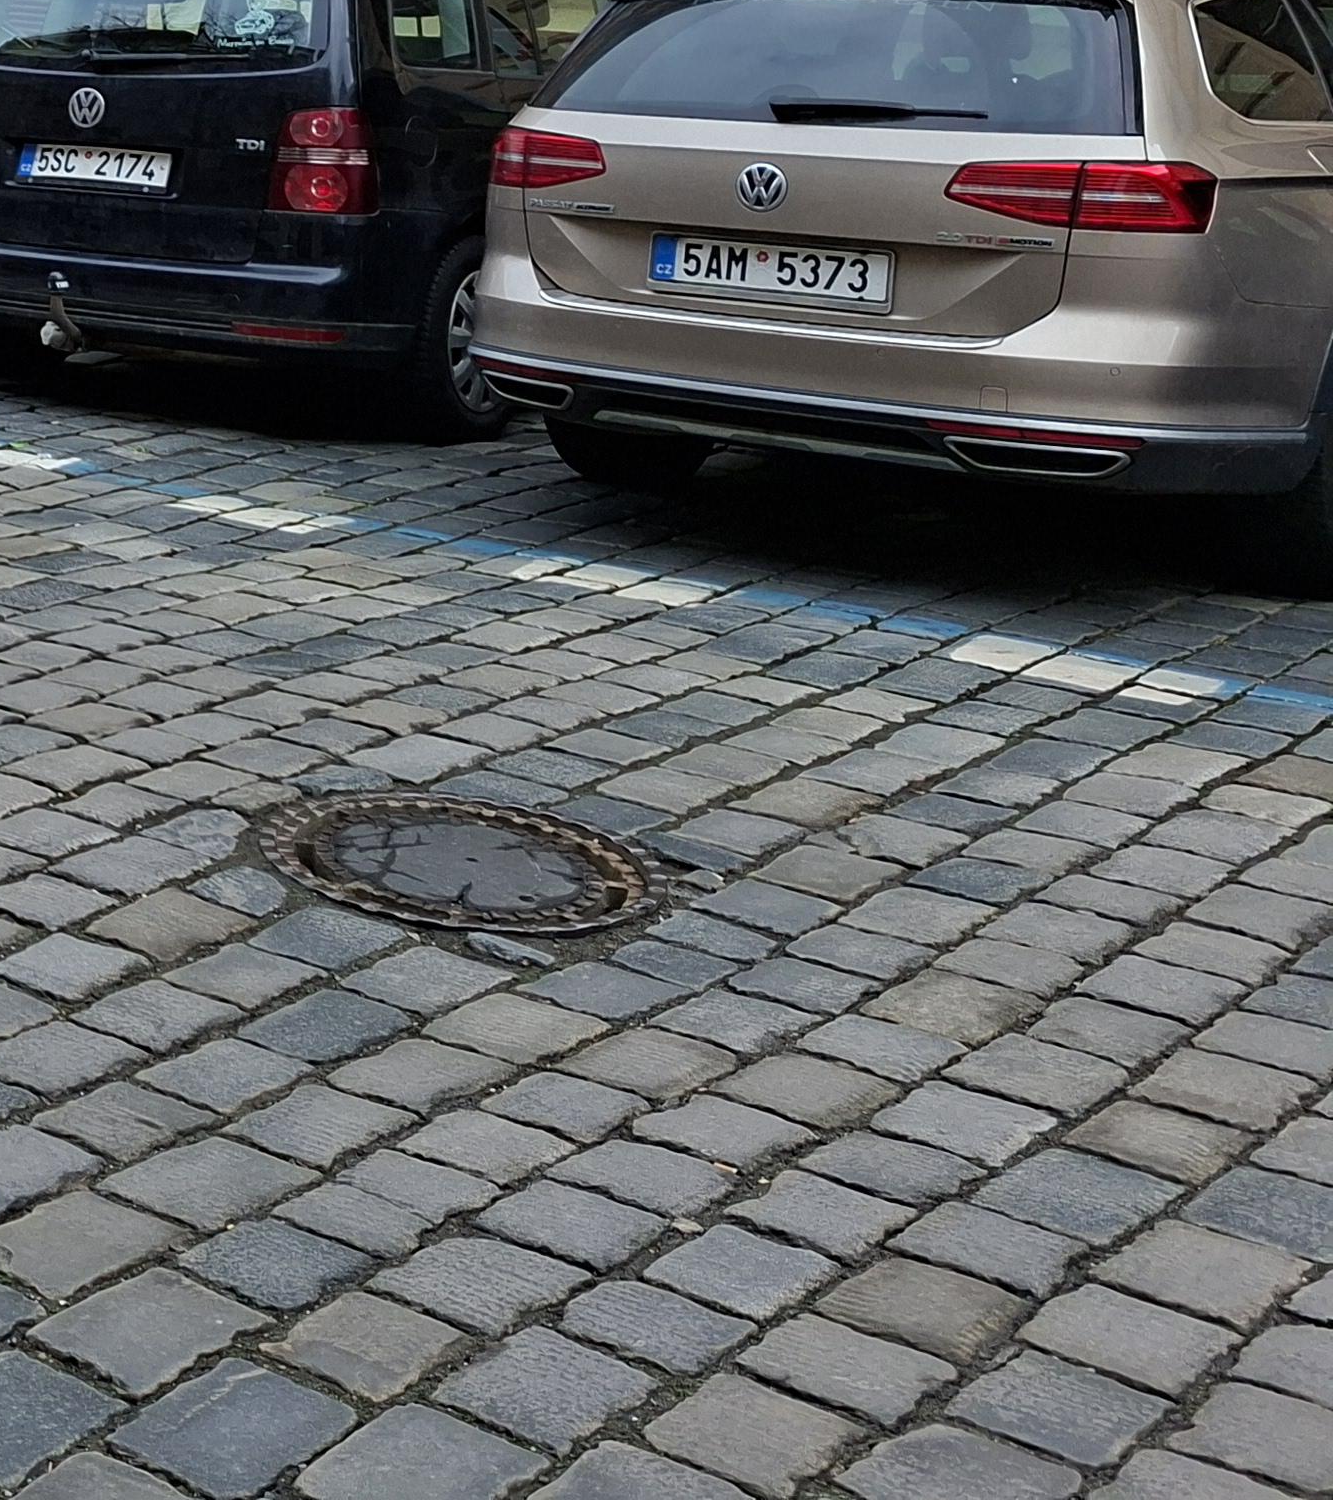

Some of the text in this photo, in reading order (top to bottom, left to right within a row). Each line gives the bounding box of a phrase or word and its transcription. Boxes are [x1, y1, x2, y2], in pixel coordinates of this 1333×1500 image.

[236, 138, 266, 151] TDI
[37, 147, 79, 173] 5SC
[94, 151, 156, 181] 2174
[964, 234, 993, 245] TDI
[656, 243, 870, 293] CZ 5AM 5373
